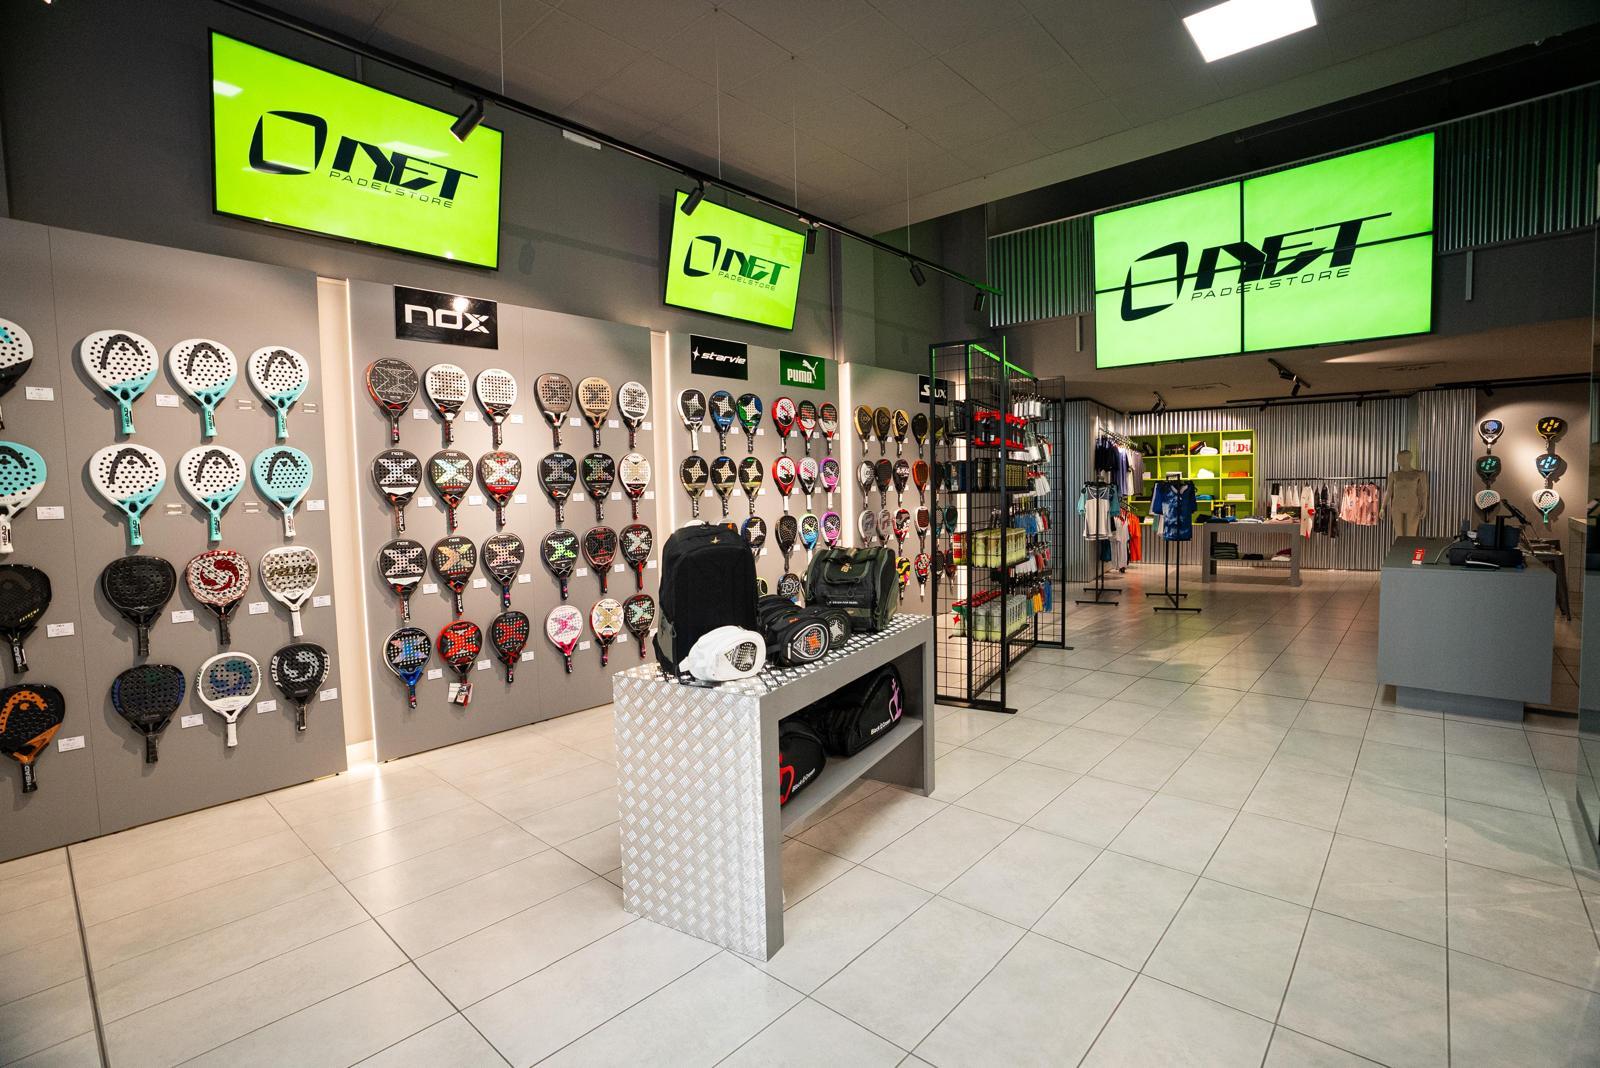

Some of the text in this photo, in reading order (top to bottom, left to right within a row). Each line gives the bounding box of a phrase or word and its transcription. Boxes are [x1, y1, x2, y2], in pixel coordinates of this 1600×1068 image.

[329, 170, 454, 209] PADELSTORE
[718, 271, 776, 291] PADELSTORE
[1191, 267, 1351, 301] PADELSTORE
[701, 351, 746, 365] starvie
[787, 368, 813, 384] PUMA
